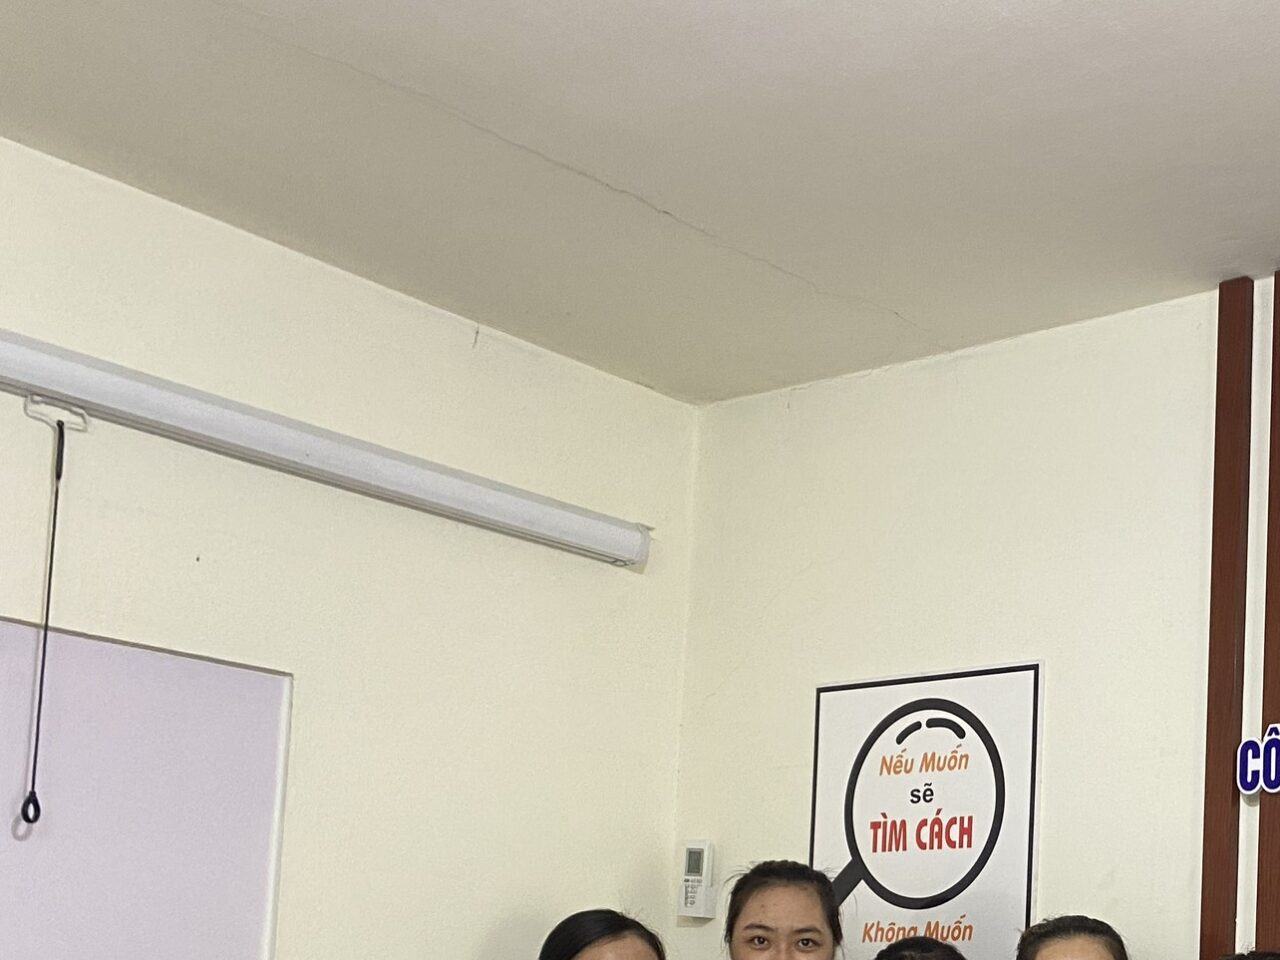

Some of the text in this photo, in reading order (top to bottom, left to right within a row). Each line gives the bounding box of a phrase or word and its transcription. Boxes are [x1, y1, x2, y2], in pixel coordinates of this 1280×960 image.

[879, 743, 970, 777] Nếu Muốn
[909, 782, 935, 804] sẽ
[870, 808, 973, 853] TÌM CÁCH
[924, 912, 973, 942] Muốn
